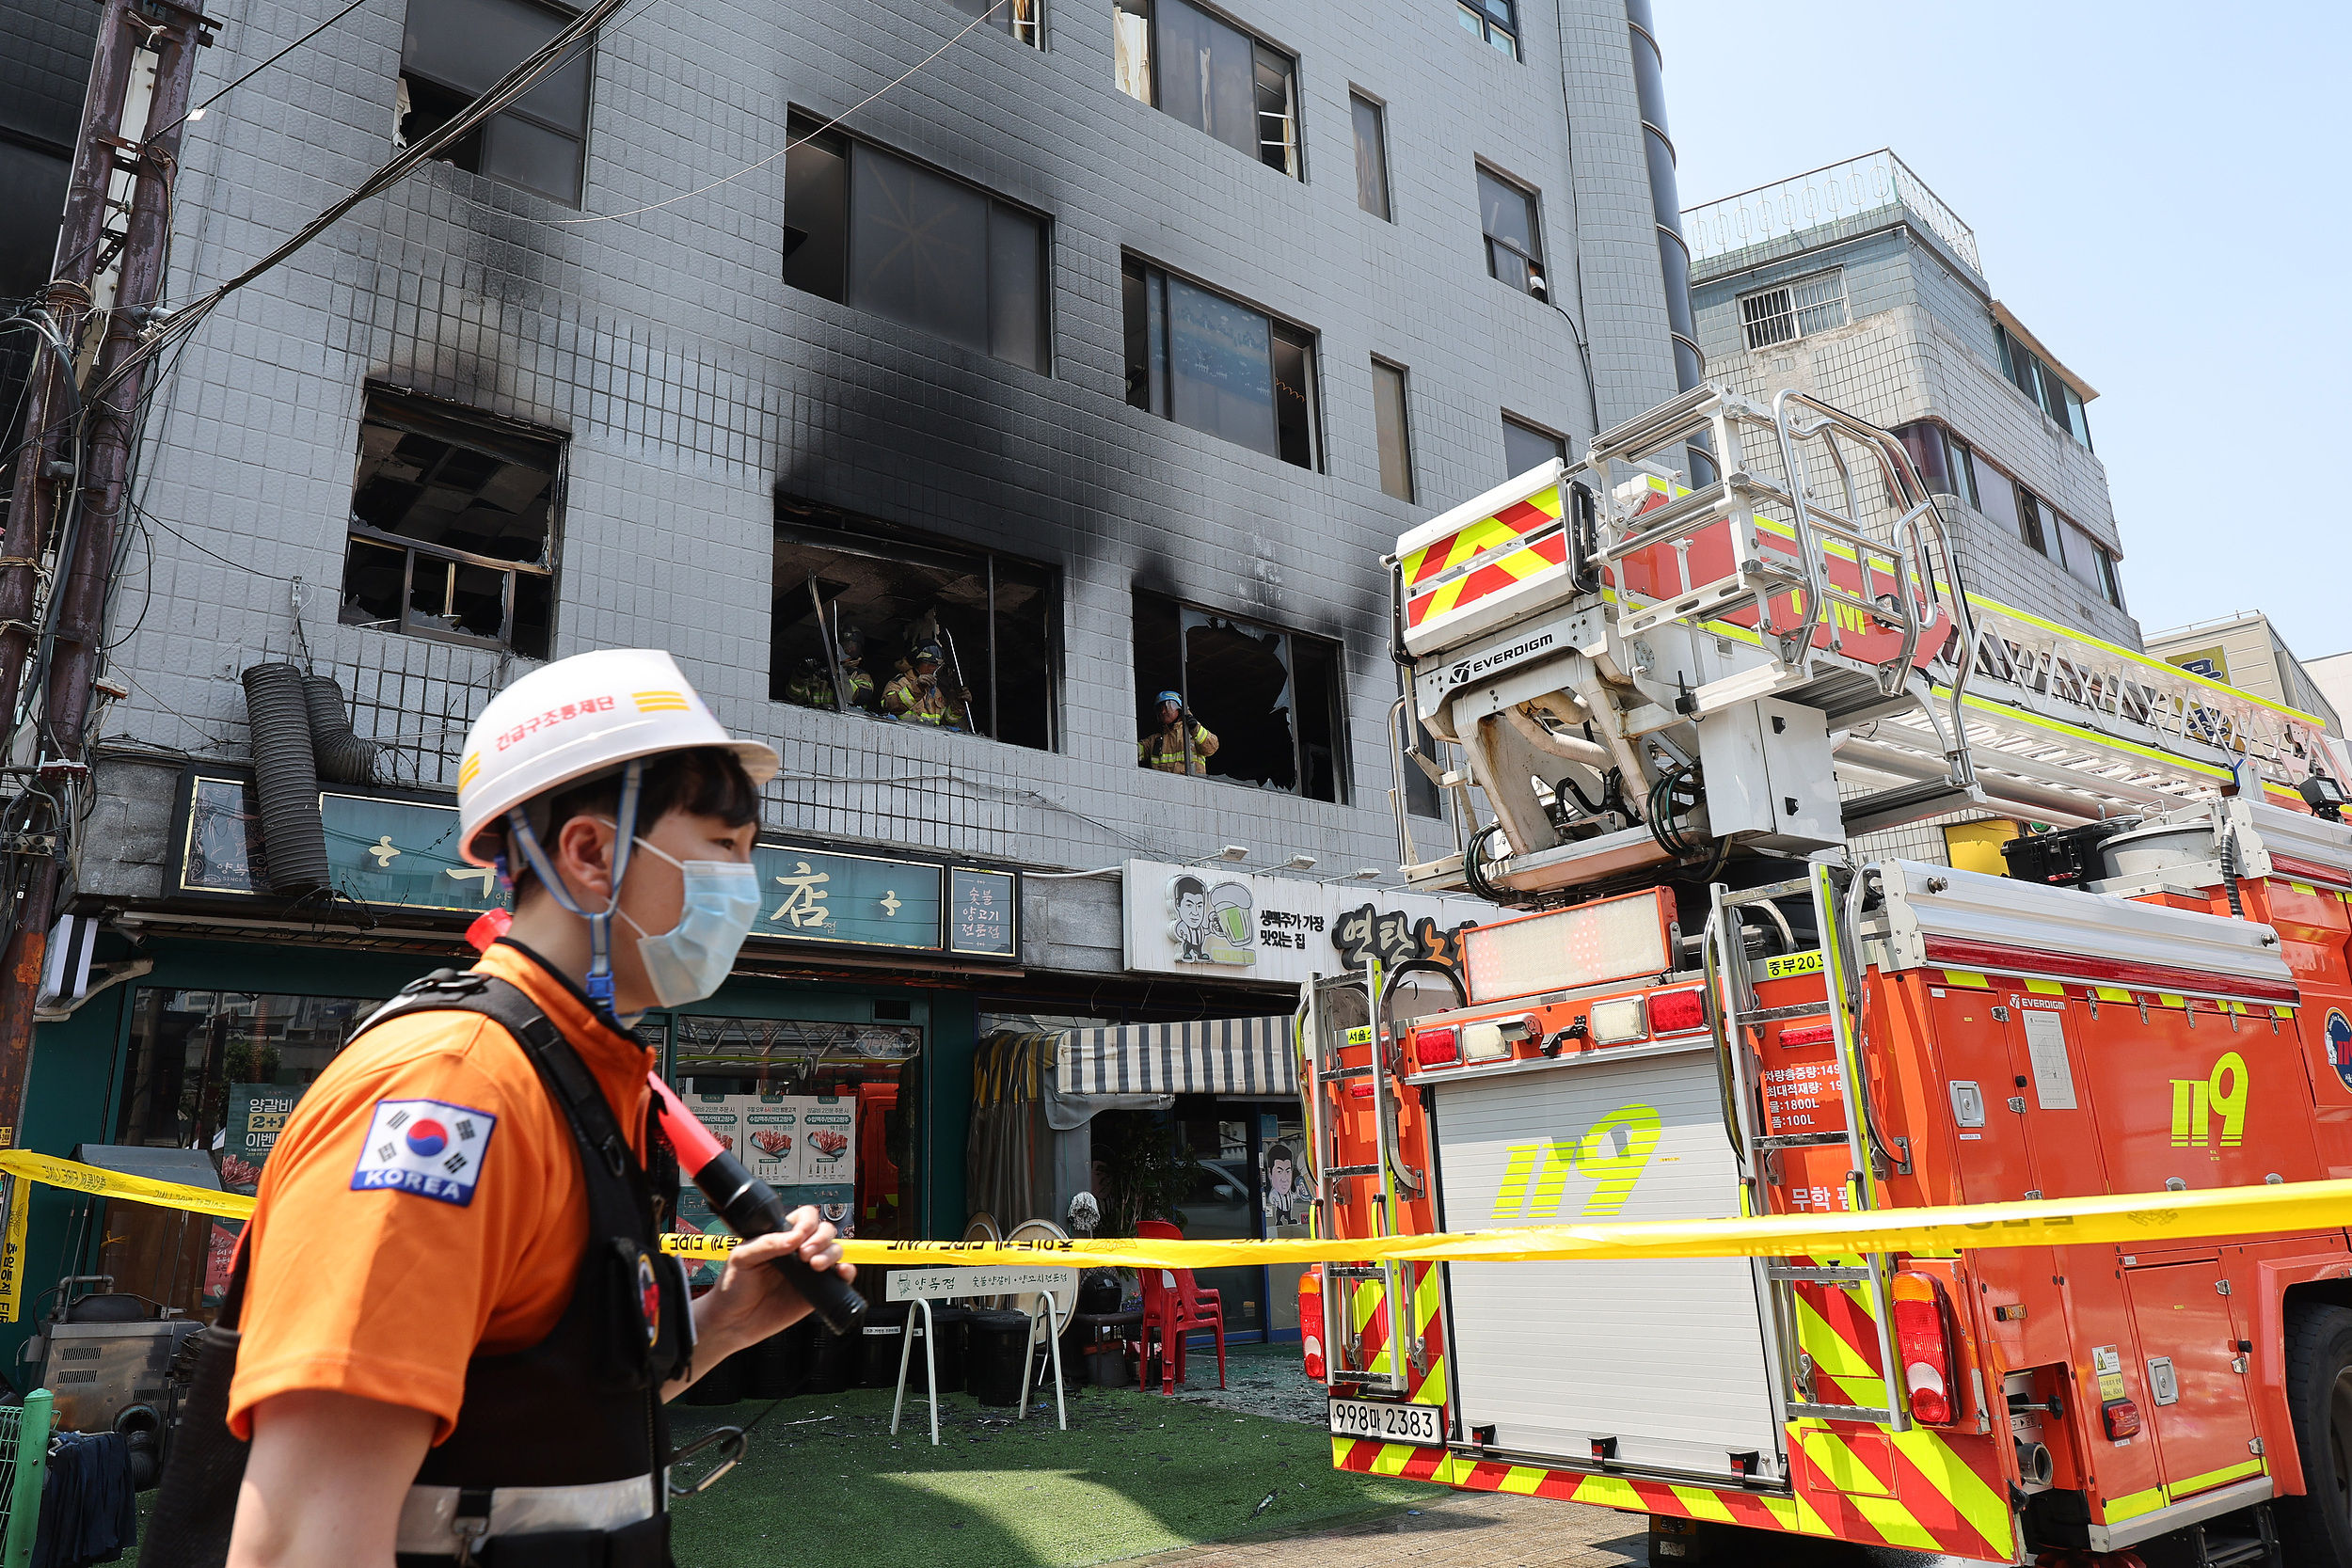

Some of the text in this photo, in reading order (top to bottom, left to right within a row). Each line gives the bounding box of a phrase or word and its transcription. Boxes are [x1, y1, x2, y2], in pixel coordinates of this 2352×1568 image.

[1472, 633, 1553, 673] EVERDIGM
[496, 694, 615, 752] 긴급구조통제단
[770, 862, 830, 927] 店
[969, 886, 993, 906] 숯불
[962, 906, 1000, 922] 양고기
[1260, 910, 1325, 932] 생맥주가 가장
[961, 923, 1000, 939] 전문점
[1260, 929, 1306, 949] 맛있는 집
[2021, 997, 2066, 1011] EVERDIGM
[1766, 1081, 1823, 1098] 최대적재량:
[2169, 1051, 2249, 1147] 119
[249, 1099, 293, 1113] 양갈비
[252, 1115, 285, 1129] 2+1
[1772, 1114, 1816, 1129] 폼:100L
[246, 1132, 280, 1148] 이벤
[1490, 1103, 1661, 1219] 119
[363, 1169, 461, 1200] KOREA
[1791, 1186, 1831, 1212] 무학
[1385, 1407, 1433, 1438] 2383
